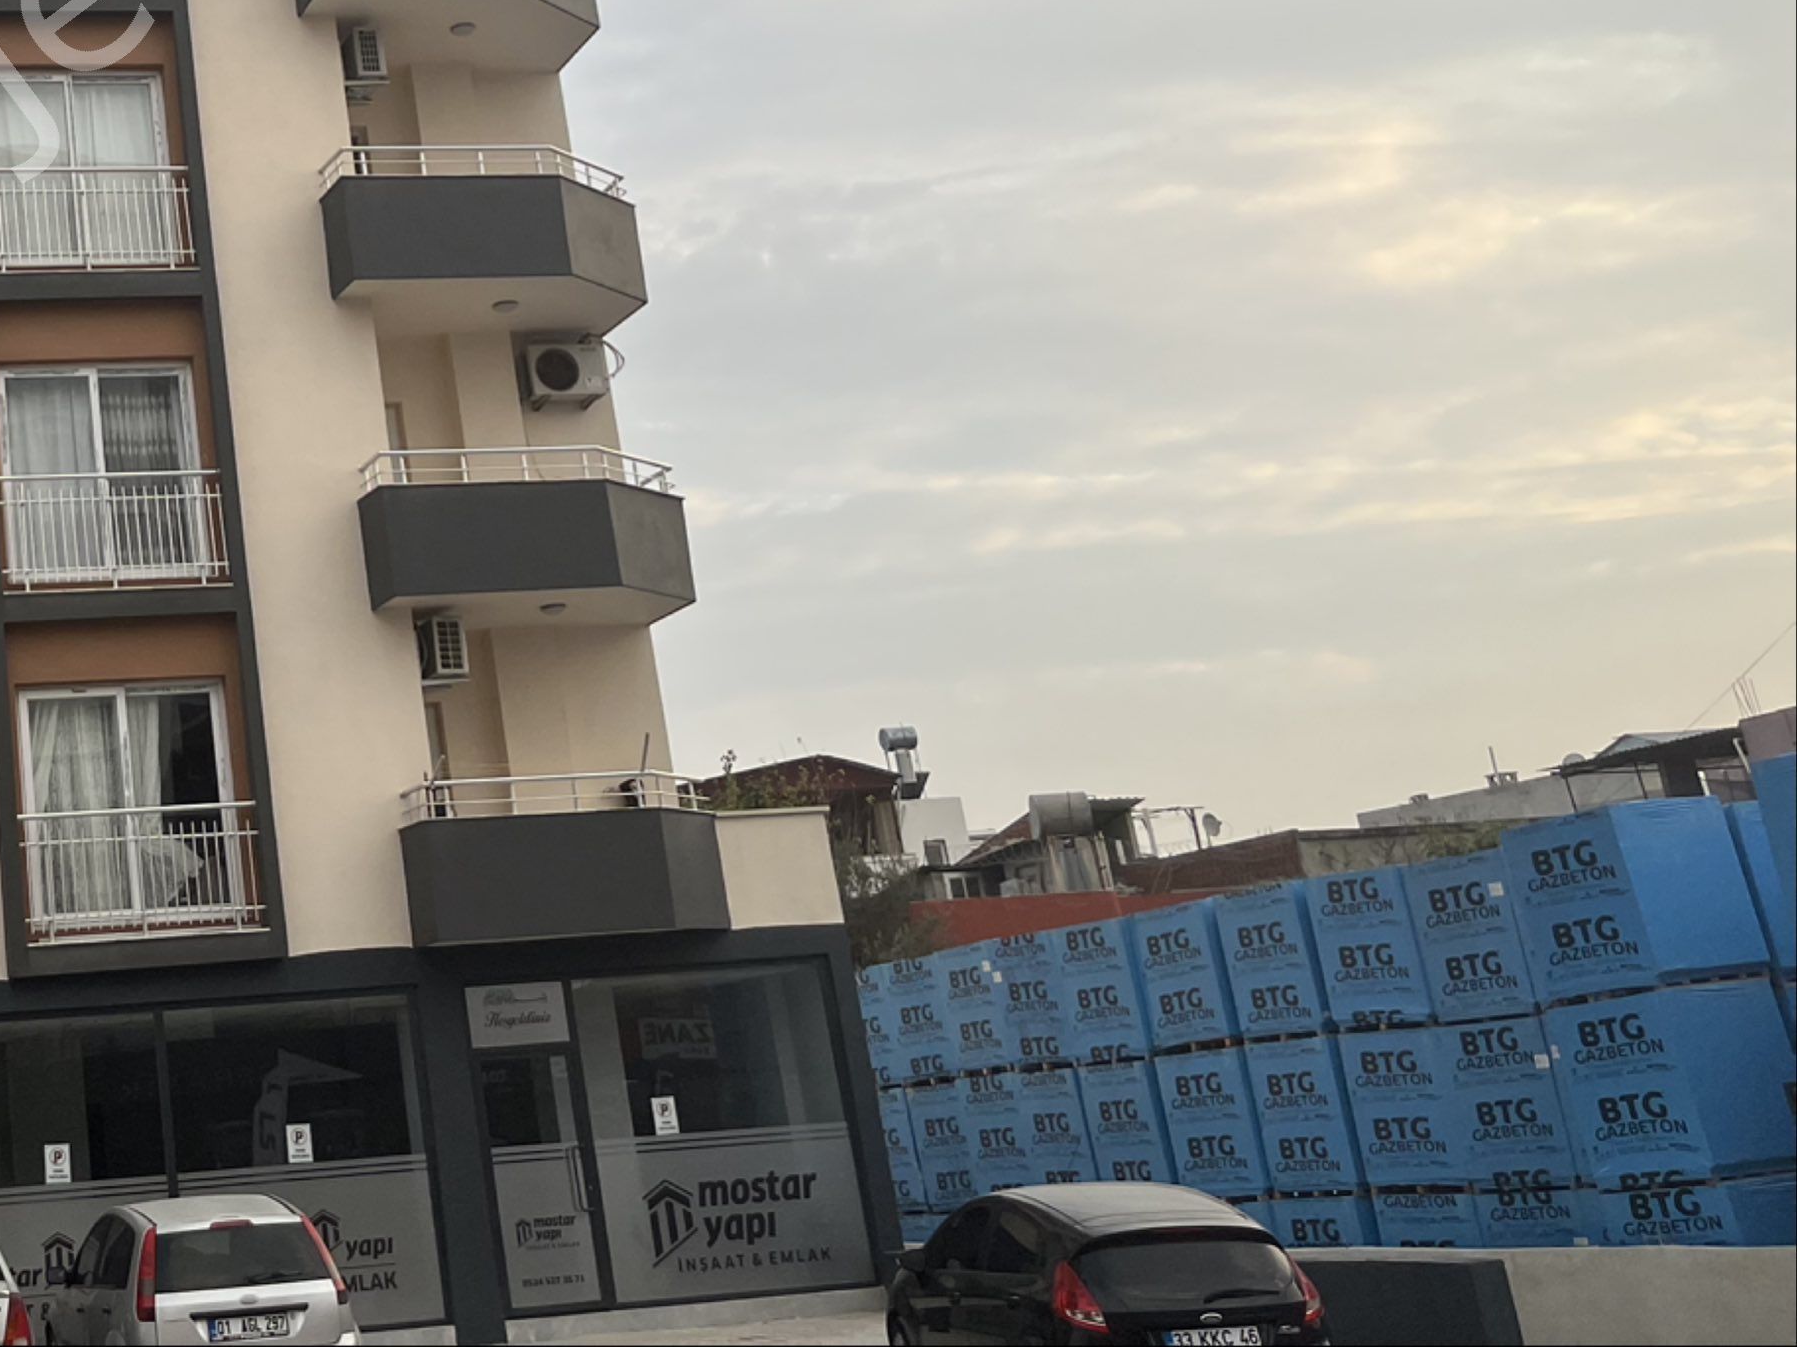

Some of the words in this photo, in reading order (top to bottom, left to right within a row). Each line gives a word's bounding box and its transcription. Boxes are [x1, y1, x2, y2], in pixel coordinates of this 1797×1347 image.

[1531, 839, 1598, 877] BTG
[1326, 877, 1379, 904] BTG
[1528, 864, 1617, 893] GAZBETON
[1321, 899, 1394, 917] GAZBETON
[1428, 881, 1486, 913] BTG
[1426, 904, 1501, 929] GAZBETON
[1066, 927, 1105, 951] BTG
[1147, 929, 1190, 956] BTG
[1237, 922, 1286, 948] BTG
[1552, 915, 1621, 949] BTG
[1339, 943, 1394, 968] BTG
[1549, 941, 1640, 967] GAZBETON
[949, 967, 981, 989] BTG
[1334, 966, 1410, 982] GAZBETON
[1445, 952, 1503, 981] BTG
[1009, 981, 1048, 1001] BTG
[1077, 985, 1119, 1009] BTG
[1251, 985, 1300, 1010] BTG
[1442, 975, 1519, 997] GAZBETON
[1159, 988, 1204, 1015] BTG
[901, 1004, 933, 1025] BTG
[960, 1020, 992, 1041] BTG
[1459, 1027, 1519, 1056] BTG
[1577, 1013, 1646, 1047] BTG
[1020, 1036, 1060, 1056] BTG
[1574, 1038, 1666, 1065] GAZBETON
[910, 1054, 944, 1075] BTG
[1360, 1050, 1418, 1074] BTG
[1456, 1051, 1535, 1071] GAZBETON
[1175, 1072, 1222, 1097] BTG
[1266, 1071, 1315, 1096] BTG
[1355, 1073, 1433, 1087] GAZBETON
[1099, 1099, 1138, 1122] BTG
[1475, 1097, 1538, 1127] BTG
[1597, 1091, 1668, 1124] BTG
[924, 1116, 959, 1137] BTG
[1033, 1113, 1070, 1133] BTG
[1373, 1117, 1432, 1141] BTG
[1472, 1124, 1554, 1142] GAZBETON
[1595, 1119, 1689, 1142] GAZBETON
[979, 1127, 1016, 1148] BTG
[1187, 1135, 1235, 1159] BTG
[1278, 1136, 1329, 1160] BTG
[1369, 1140, 1447, 1155] GAZBETON
[936, 1170, 971, 1190] BTG
[1113, 1160, 1152, 1181] BTG
[699, 1170, 817, 1207] mostar
[1490, 1205, 1571, 1222] GAZBETON
[1628, 1187, 1702, 1221] BTG
[533, 1215, 576, 1228] mostar
[703, 1211, 776, 1248] yapı
[1291, 1218, 1340, 1242] BTG
[1623, 1215, 1724, 1238] GAZBETON
[345, 1237, 393, 1262] yapı
[678, 1253, 745, 1274] İNŞAAT
[752, 1253, 763, 1266] &
[770, 1247, 832, 1266] EMLAK
[343, 1271, 397, 1294] MLAK
[217, 1320, 230, 1334] 01
[265, 1315, 285, 1330] 297
